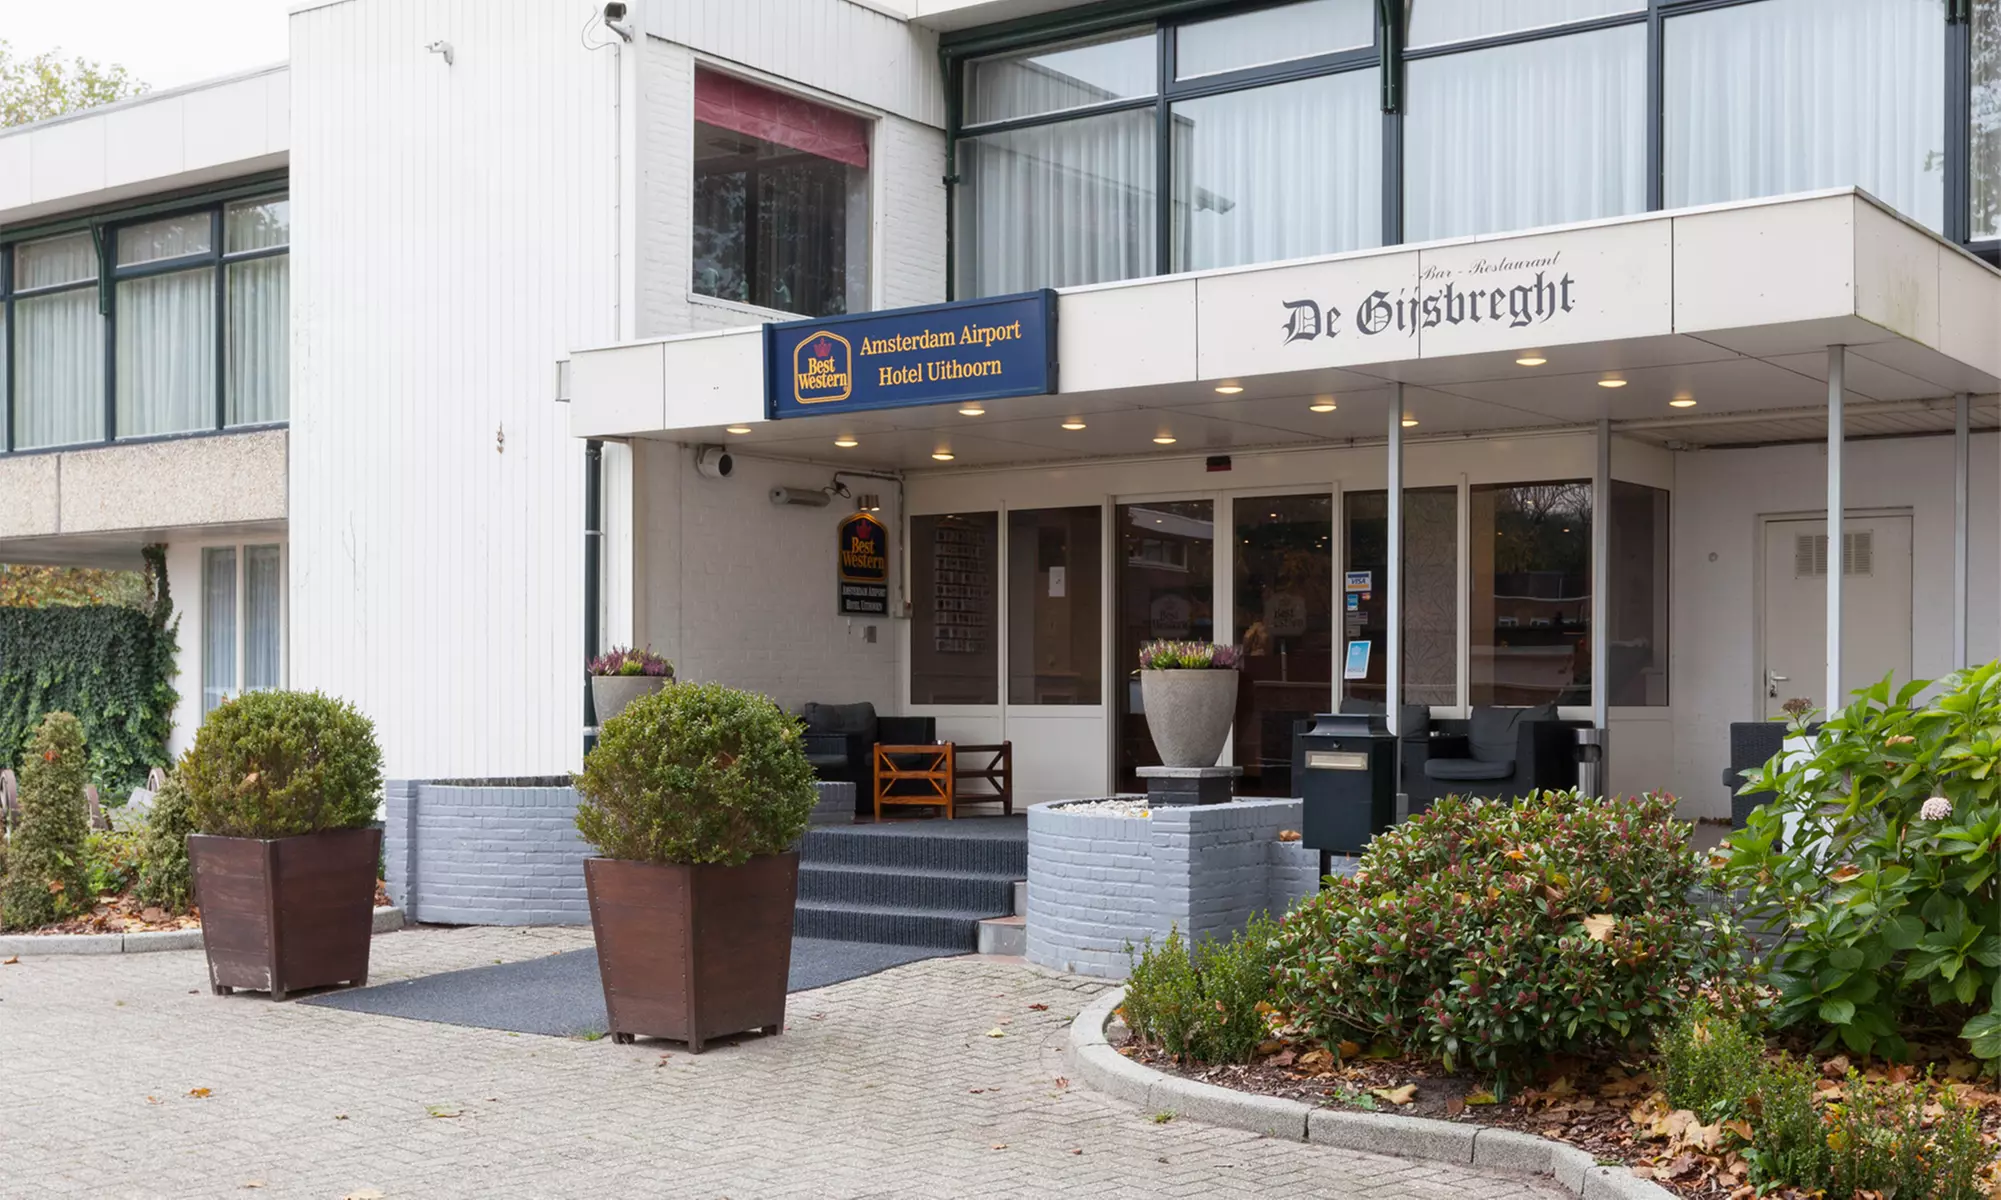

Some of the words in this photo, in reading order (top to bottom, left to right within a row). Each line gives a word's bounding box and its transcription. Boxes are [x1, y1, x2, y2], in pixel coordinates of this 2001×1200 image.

[1419, 264, 1451, 281] Bar
[1468, 250, 1561, 275] Restaurant
[1281, 299, 1341, 346] De
[860, 329, 955, 356] Amsterdam
[959, 319, 1022, 347] Airport
[808, 356, 836, 375] Best
[878, 363, 923, 386] Hotel
[927, 359, 1002, 382] Uithoorn
[798, 372, 848, 390] Western
[851, 536, 875, 554] Best
[842, 549, 885, 569] Western
